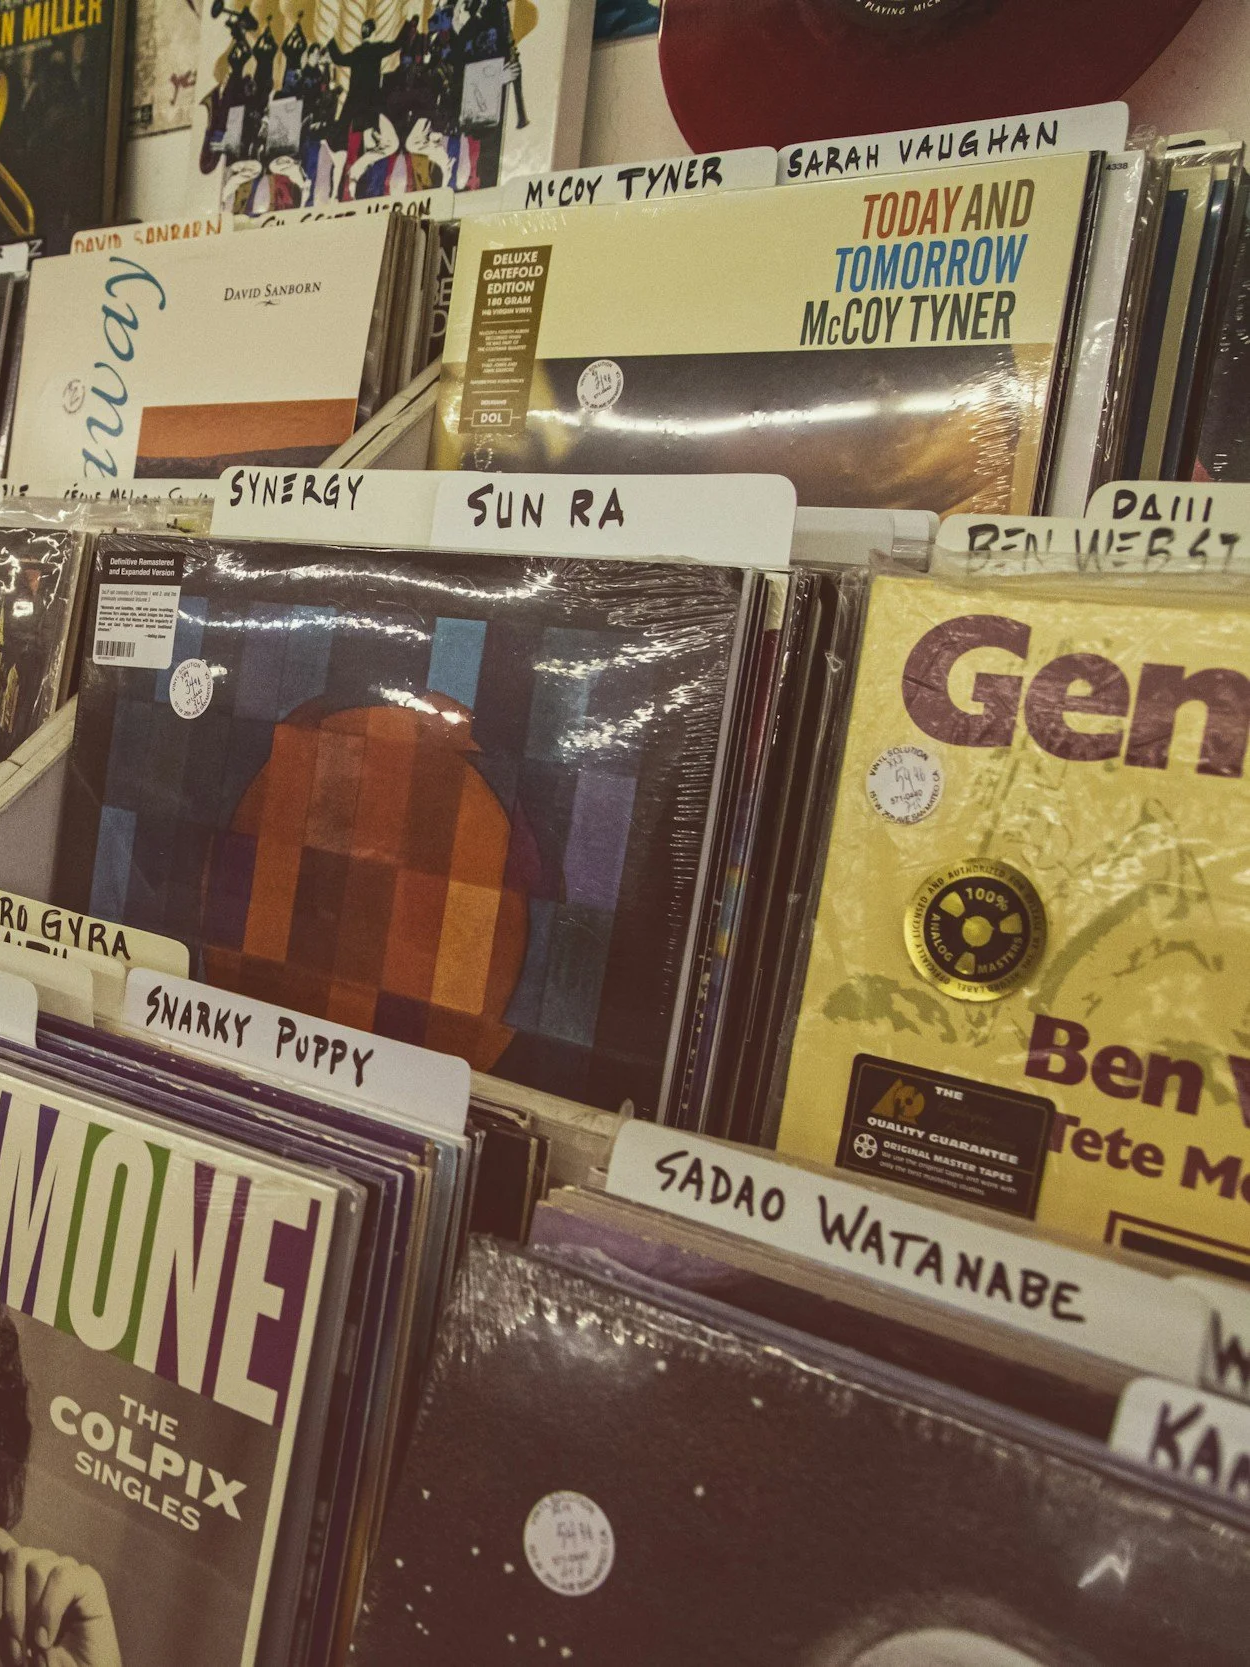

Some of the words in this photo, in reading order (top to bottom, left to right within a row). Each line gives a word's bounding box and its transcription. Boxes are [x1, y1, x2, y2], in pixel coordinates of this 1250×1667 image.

[22, 0, 102, 42] MILLER
[864, 1, 906, 15] PLAYING
[787, 146, 879, 179] SARAH
[897, 119, 1059, 163] VAUGHAN
[1105, 162, 1129, 171] 4338
[617, 156, 724, 200] TYNER
[861, 186, 962, 240] TODAY
[961, 178, 1037, 231] AND
[74, 233, 122, 254] DAVID
[492, 251, 539, 266] DELUXE
[835, 234, 1029, 293] TOMORROW
[223, 286, 261, 302] DAVID
[264, 281, 322, 298] SANBORN
[483, 265, 544, 280] GATEFOLD
[486, 280, 536, 295] EDITION
[487, 297, 502, 306] 180
[504, 295, 531, 306] GRAM
[493, 307, 514, 315] VIRGIN
[907, 290, 1017, 342] TYNER
[480, 412, 503, 424] DOL
[230, 469, 366, 511] SYNERGY
[466, 483, 544, 529] SUN
[569, 488, 625, 529] RA
[110, 557, 138, 566] Definitive
[139, 558, 175, 567] Remastered
[967, 523, 1053, 573] BEN
[109, 567, 120, 575] and
[121, 568, 151, 577] Expanded
[152, 569, 175, 577] Version
[902, 614, 1250, 778] Gen
[870, 755, 887, 777] VINYL
[887, 746, 928, 761] SOLUTION
[927, 877, 945, 894] AND
[965, 887, 1009, 912] 100%
[41, 909, 131, 961] GYRA
[930, 913, 954, 962] ANALOG
[977, 936, 1023, 974] MASTERS
[146, 985, 252, 1050] SNARKY
[277, 1016, 375, 1088] PUPPY
[1024, 1013, 1204, 1117] Ben
[934, 1085, 965, 1101] THE
[867, 1116, 926, 1140] QUALITY
[928, 1133, 1020, 1165] GUARANTEE
[883, 1140, 931, 1161] ORIGINAL
[933, 1153, 976, 1173] MASTER
[979, 1166, 1014, 1183] TAPES
[1049, 1110, 1166, 1179] Tete
[1180, 1144, 1250, 1206] M
[879, 1160, 894, 1170] only
[895, 1161, 907, 1172] the
[908, 1166, 922, 1177] best
[905, 1156, 917, 1167] the
[918, 1160, 944, 1175] original
[966, 1171, 980, 1184] and
[1000, 1182, 1018, 1195] with
[654, 1149, 786, 1222] SADAO
[817, 1194, 1086, 1324] WATANABE
[119, 1393, 179, 1442] THE
[48, 1393, 250, 1520] COLPIX
[74, 1451, 202, 1533] SINGLES
